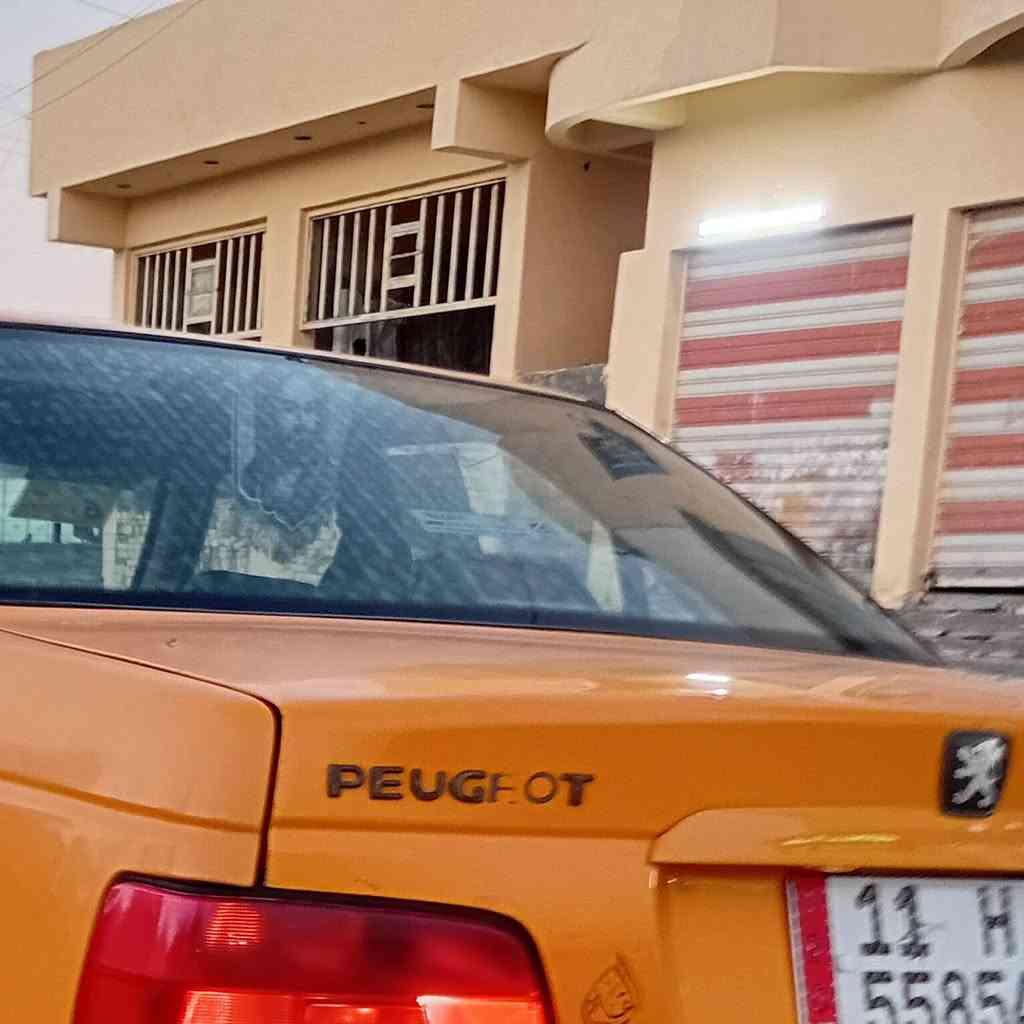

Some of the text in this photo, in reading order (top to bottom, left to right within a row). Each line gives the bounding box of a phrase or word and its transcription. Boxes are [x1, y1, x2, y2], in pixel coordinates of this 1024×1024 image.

[326, 763, 595, 806] PEUGEOT
[855, 883, 1017, 957] 11 H
